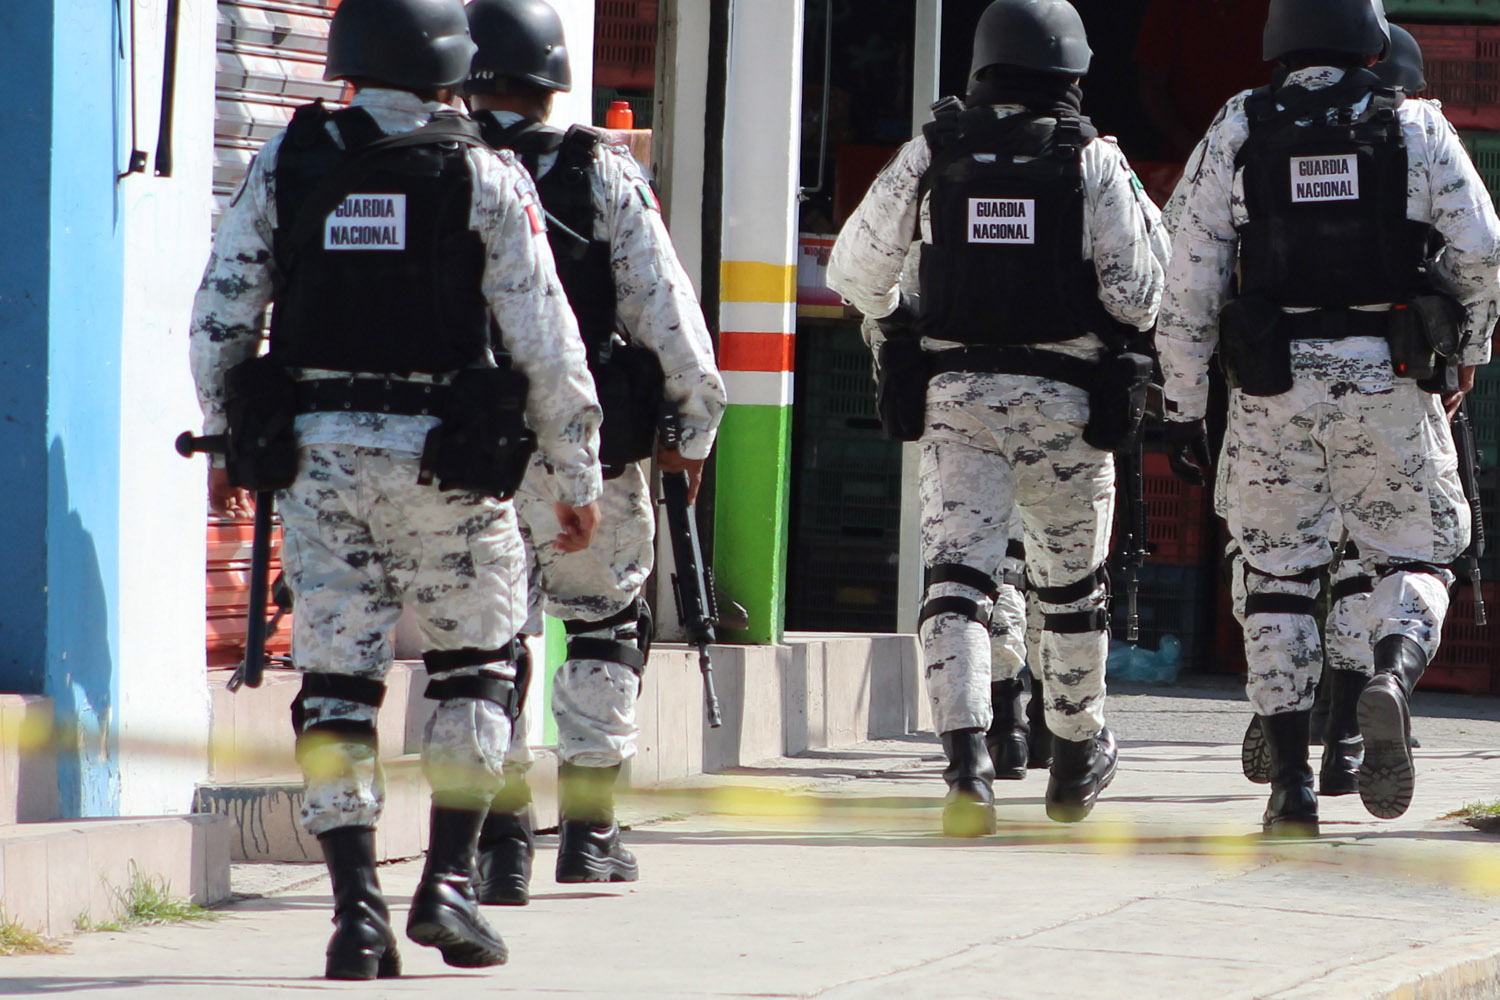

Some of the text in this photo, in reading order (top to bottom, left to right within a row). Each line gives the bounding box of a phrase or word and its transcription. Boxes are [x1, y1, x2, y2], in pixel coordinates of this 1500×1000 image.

[1299, 158, 1350, 177] GUARDIA
[1296, 180, 1355, 199] NACIONAL
[335, 198, 395, 218] GUARDIA
[976, 201, 1027, 218] GUARDIA
[330, 225, 400, 245] NACIONAL
[973, 223, 1030, 240] NACIONAL
